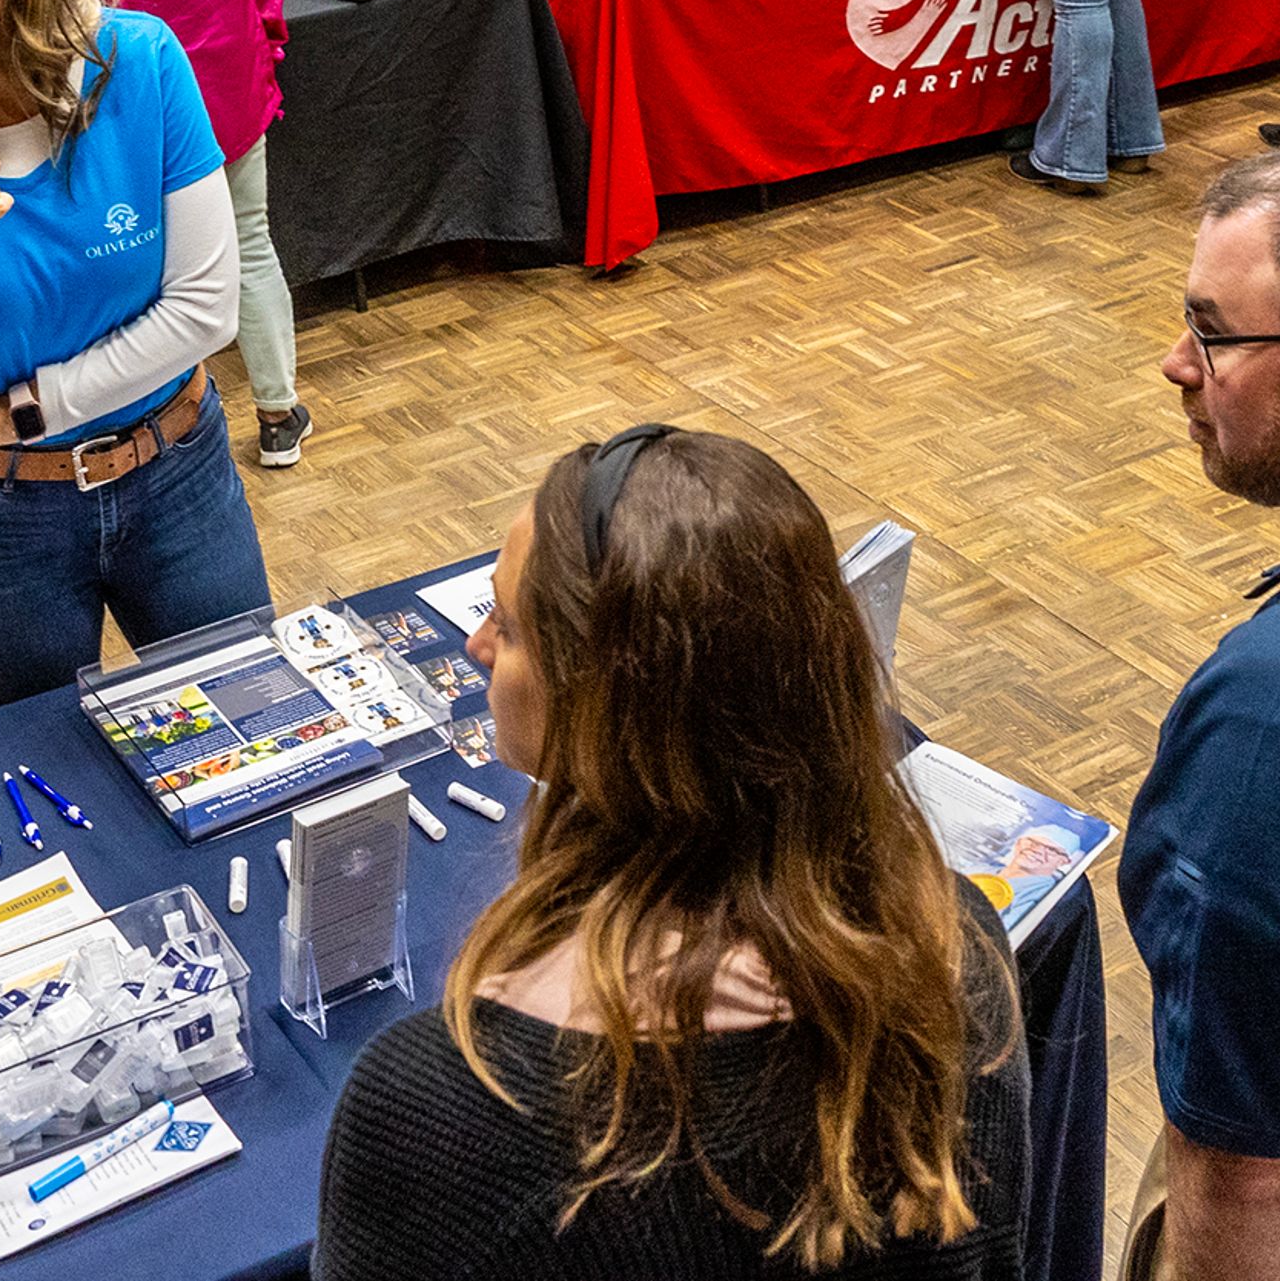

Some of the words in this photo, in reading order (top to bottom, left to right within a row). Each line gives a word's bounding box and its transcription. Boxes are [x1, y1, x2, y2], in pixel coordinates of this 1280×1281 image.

[869, 54, 1052, 104] PARTNER
[85, 238, 129, 259] OLIVE
[468, 599, 495, 618] RE
[6, 887, 57, 912] Gritman
